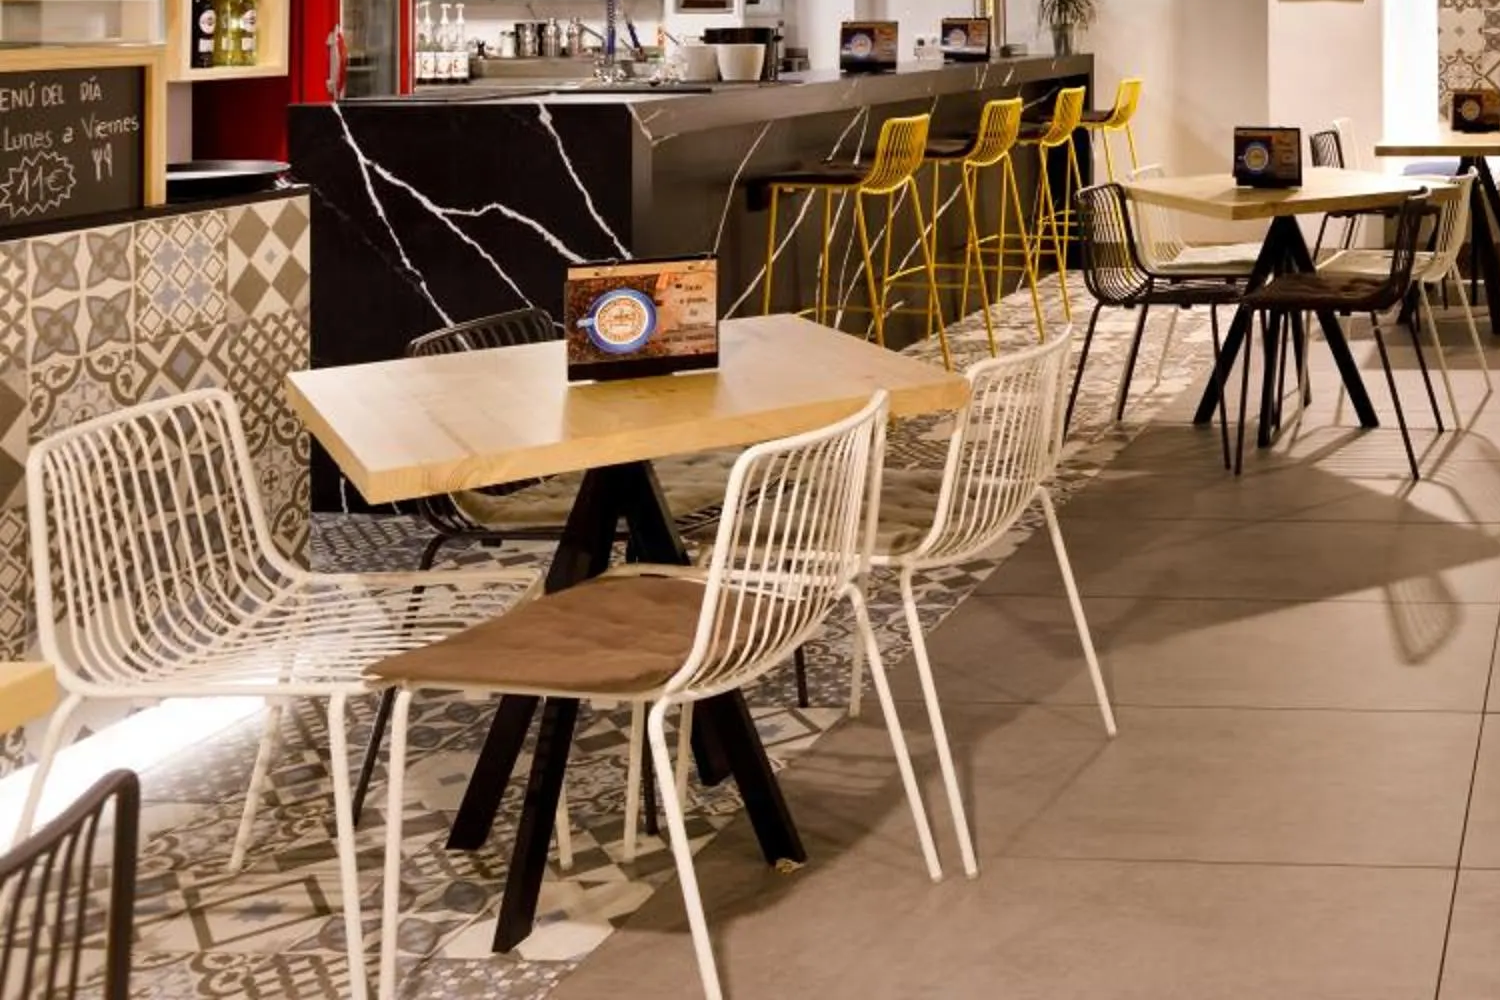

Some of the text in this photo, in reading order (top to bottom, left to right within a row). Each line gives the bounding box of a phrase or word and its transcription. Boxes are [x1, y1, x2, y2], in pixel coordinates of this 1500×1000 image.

[0, 75, 102, 111] ENÚ DEL DÍA
[4, 126, 54, 151] Lunes
[81, 112, 140, 139] Viernes
